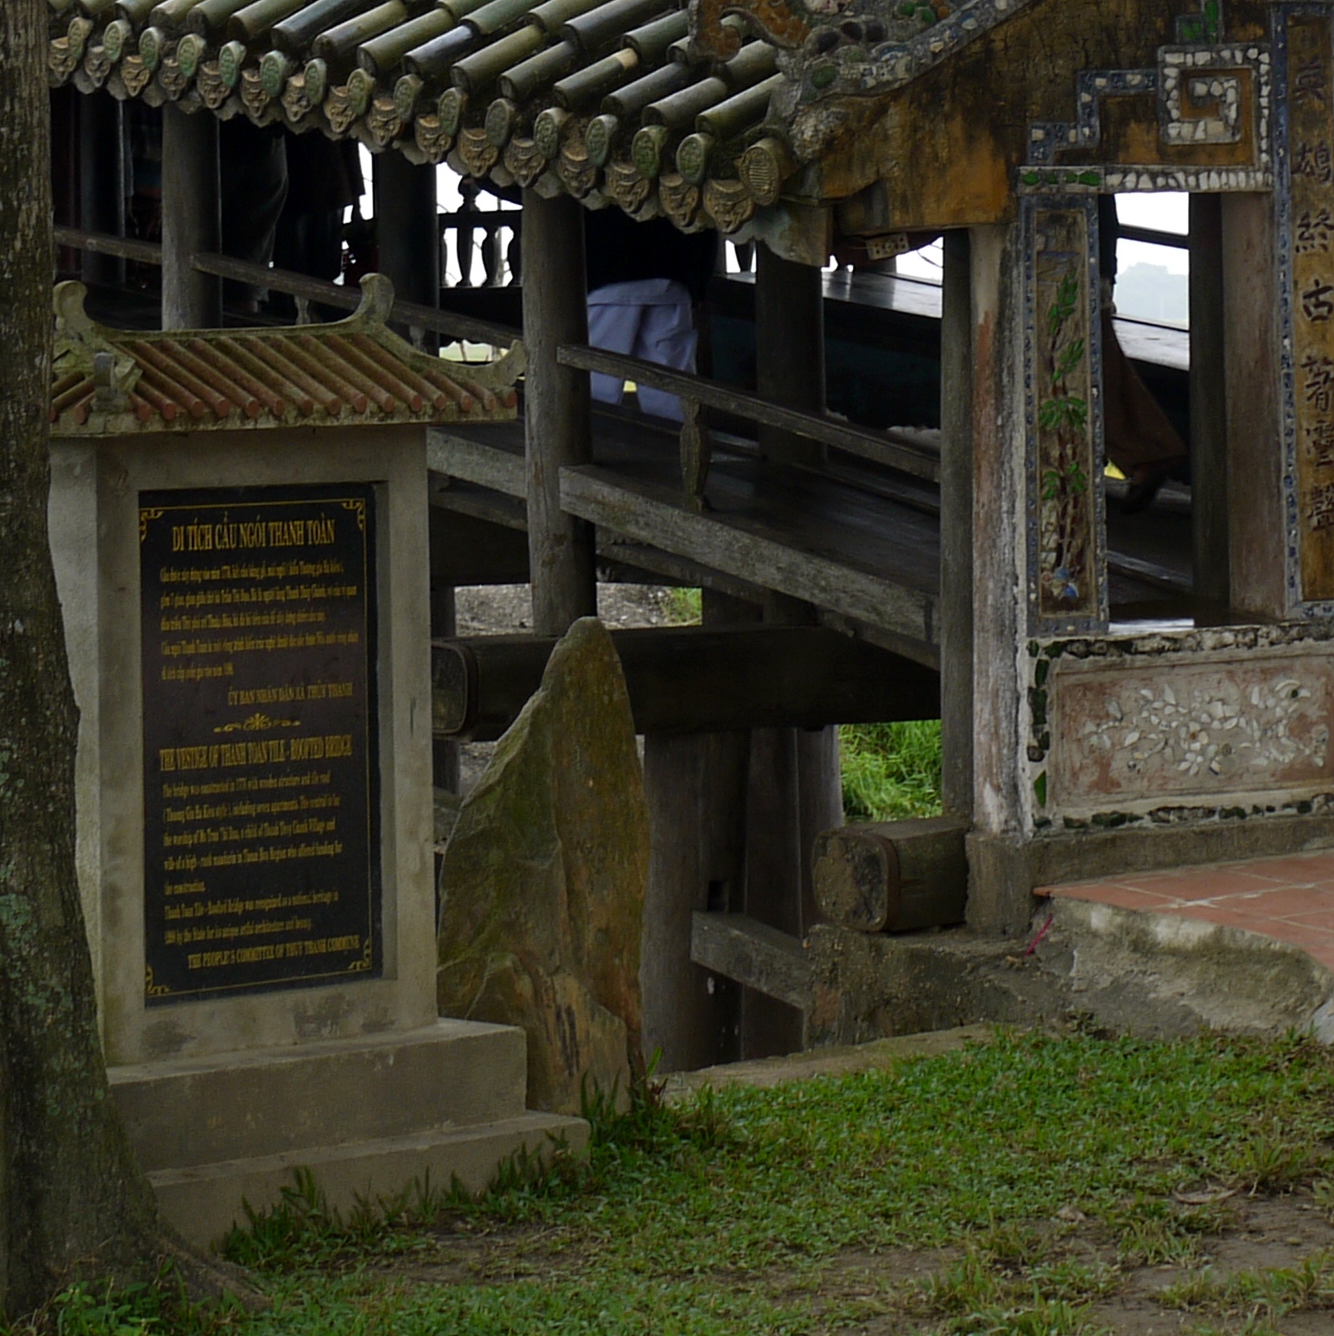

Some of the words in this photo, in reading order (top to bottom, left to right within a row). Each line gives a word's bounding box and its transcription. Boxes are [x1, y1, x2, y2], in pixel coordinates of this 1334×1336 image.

[172, 526, 184, 551] DI
[186, 517, 211, 550] TÍCH
[239, 514, 265, 548] NGÓI
[268, 521, 303, 546] THANH
[306, 513, 334, 545] TOÀN
[239, 690, 254, 704] BAN
[159, 748, 174, 771] THE
[176, 746, 207, 770] VESTIGE
[209, 745, 218, 767] OF
[220, 742, 246, 766] THANH
[247, 741, 267, 764] TOAN
[268, 739, 284, 762] TILE
[325, 735, 351, 758] BRIDGE
[188, 953, 201, 969] THE
[236, 945, 274, 963] COMMITTEE
[275, 944, 283, 958] OF
[304, 939, 326, 954] THANH
